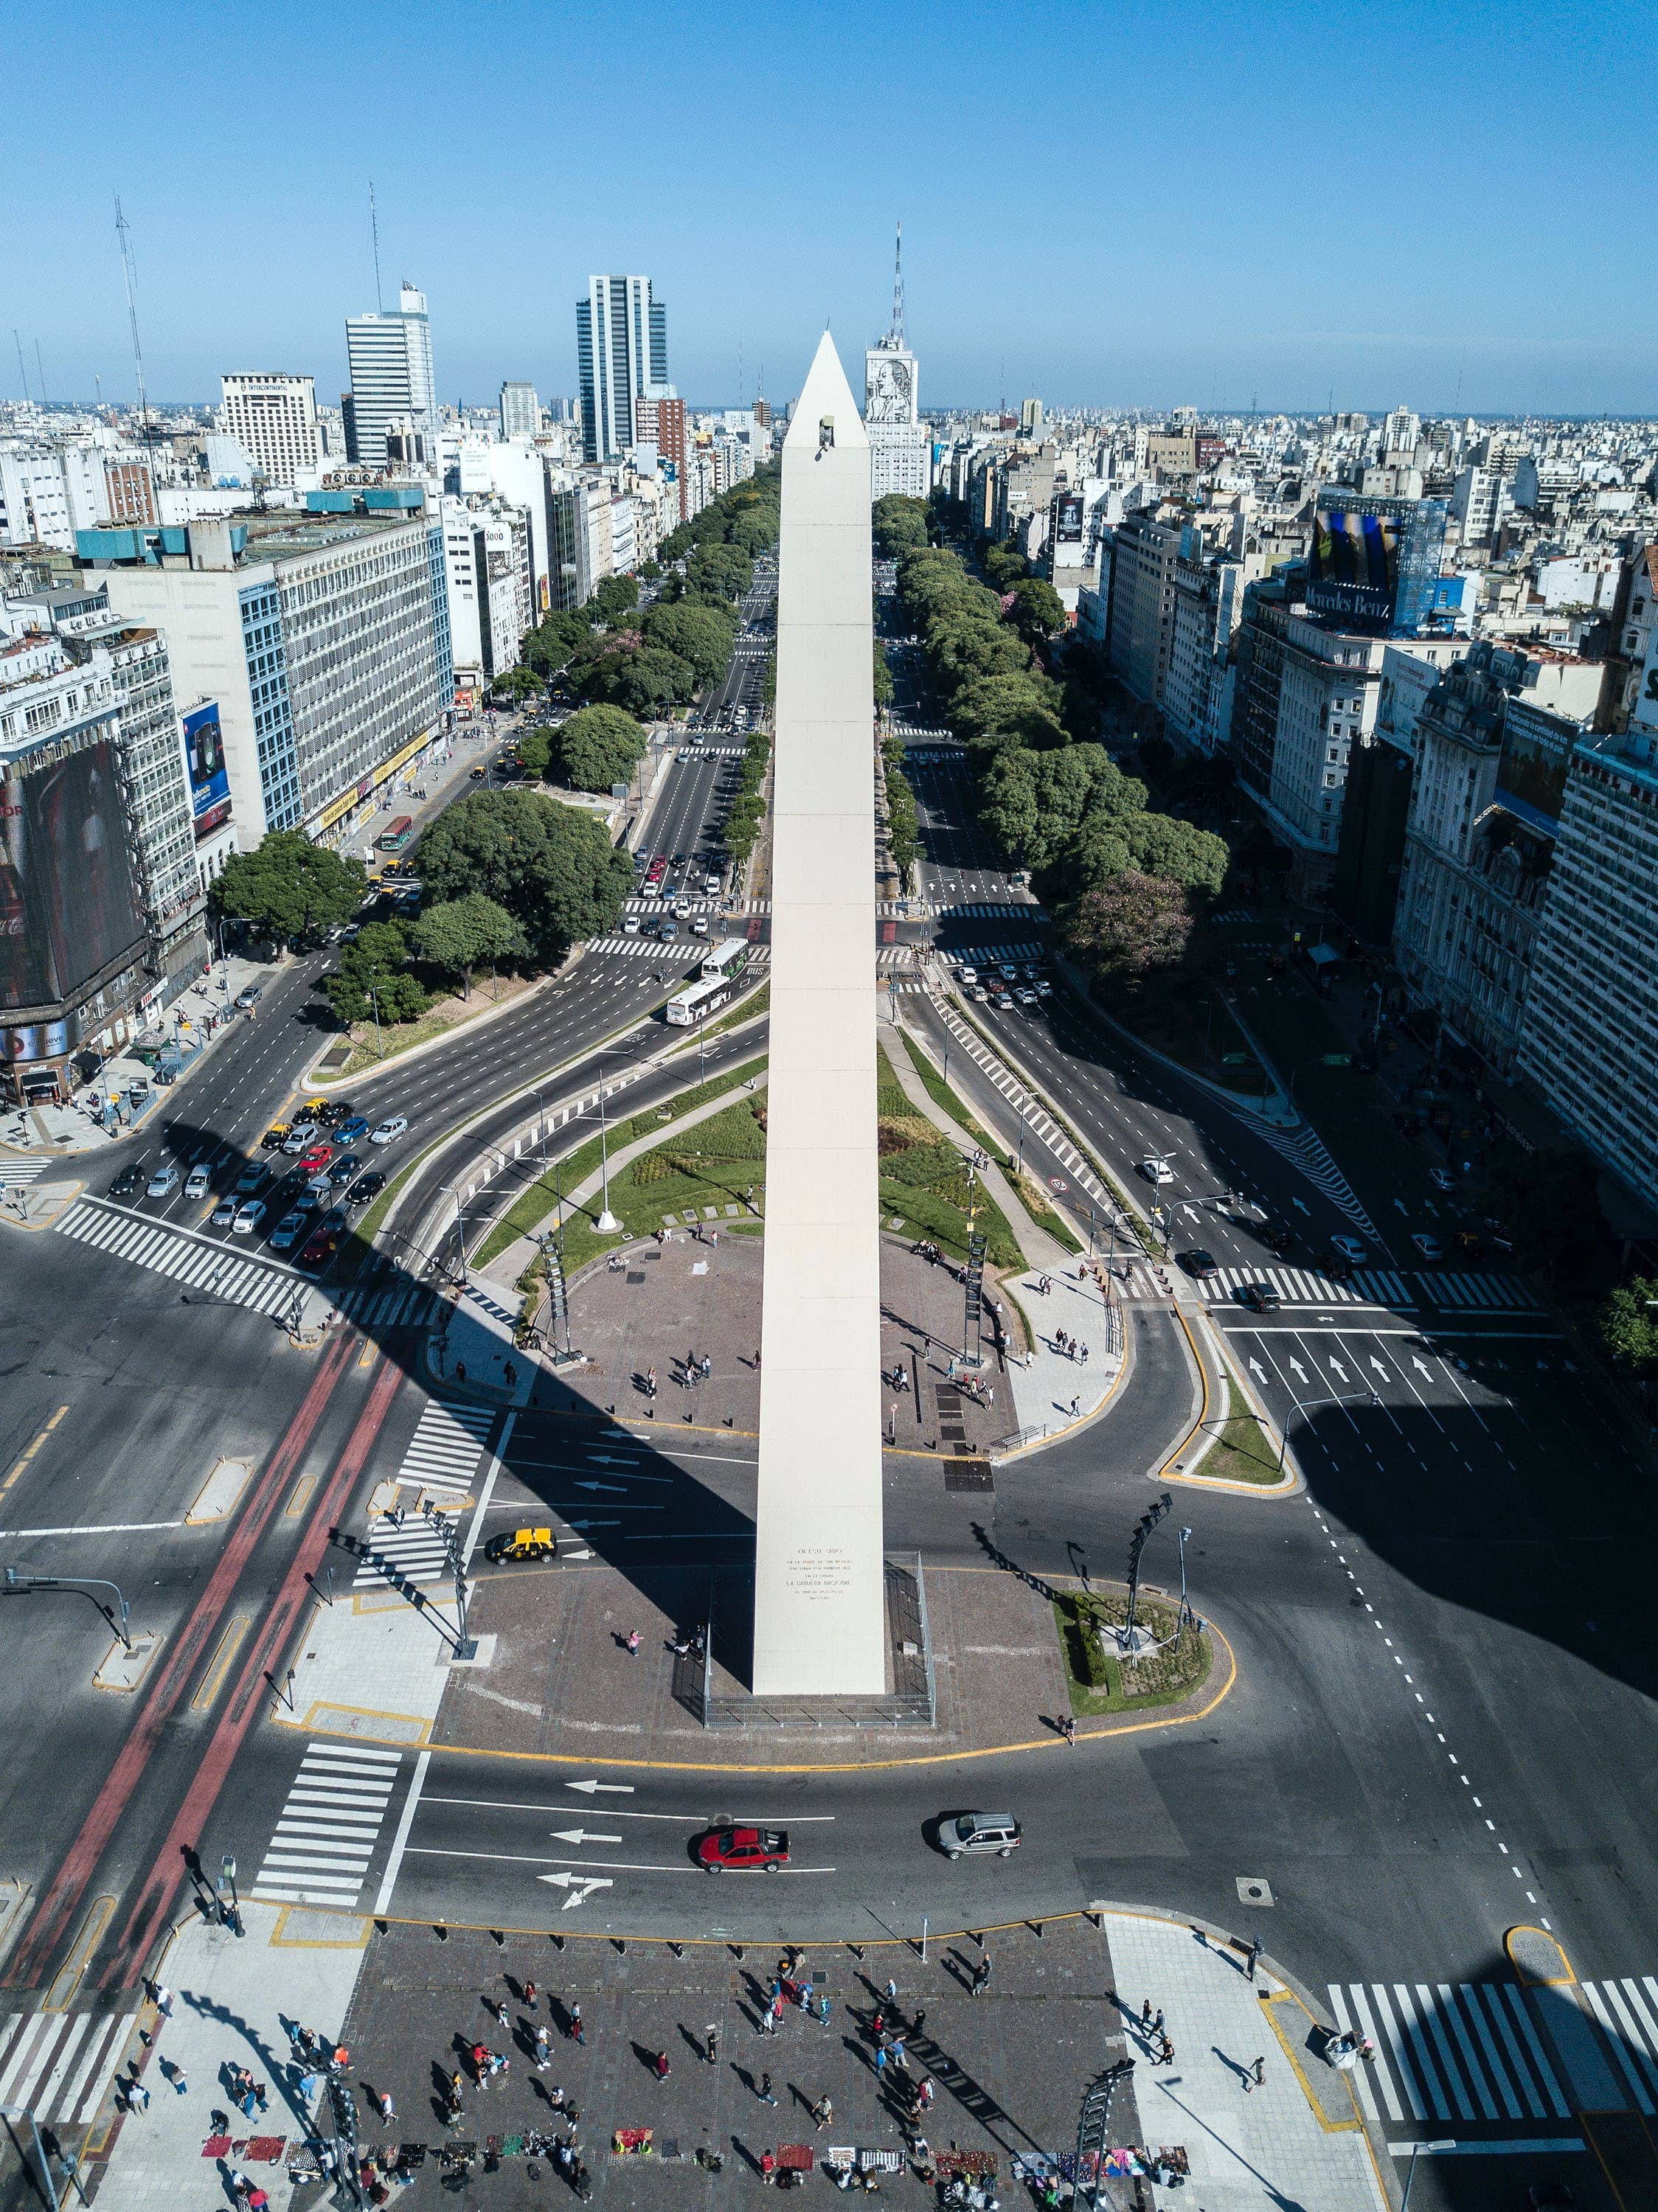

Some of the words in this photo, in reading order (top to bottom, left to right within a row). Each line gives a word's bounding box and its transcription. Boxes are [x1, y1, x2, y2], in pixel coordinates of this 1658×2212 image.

[1305, 585, 1352, 612] Mercedes
[1355, 594, 1390, 618] Benz
[746, 967, 764, 975] BUS
